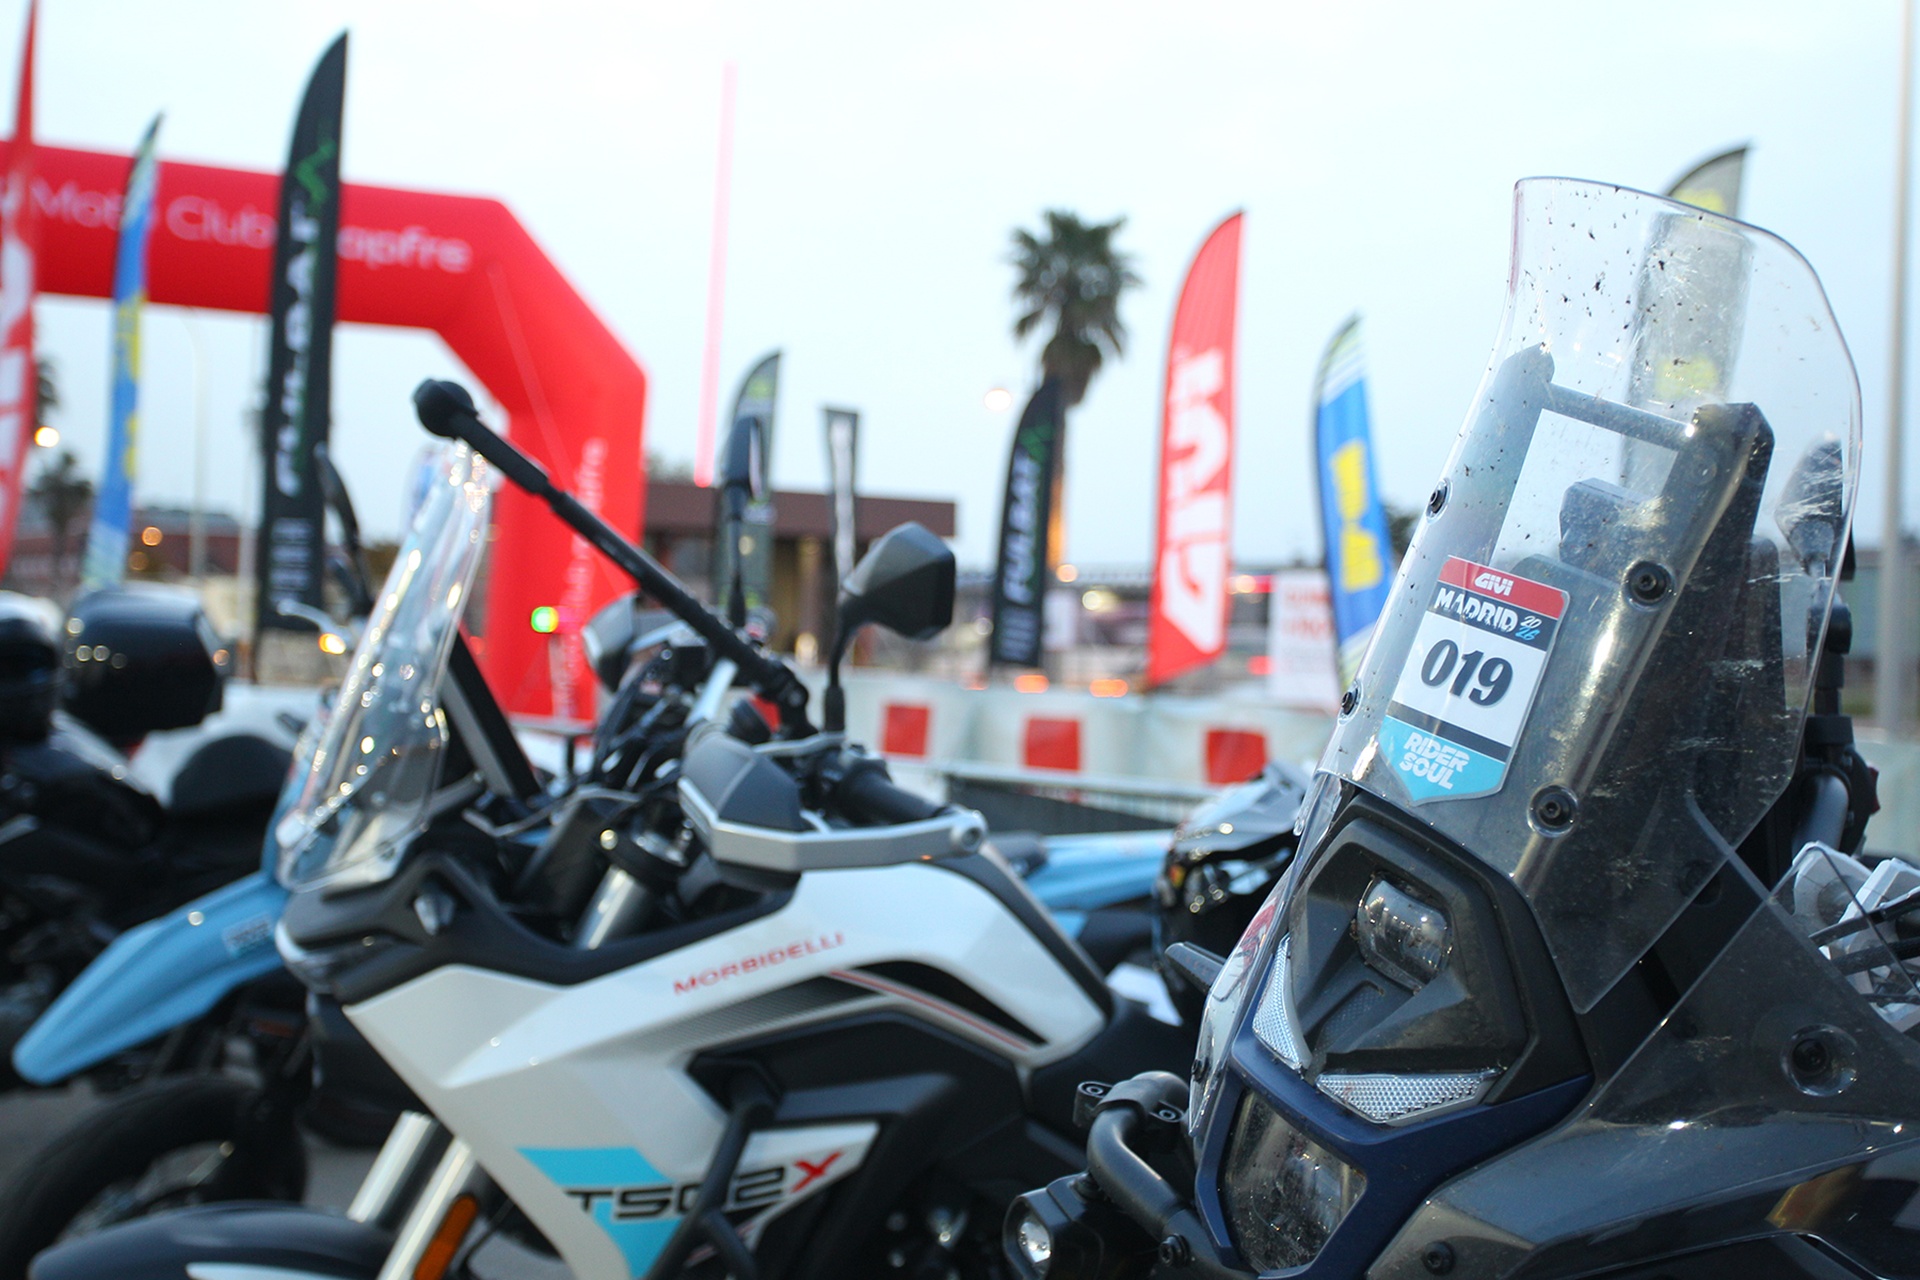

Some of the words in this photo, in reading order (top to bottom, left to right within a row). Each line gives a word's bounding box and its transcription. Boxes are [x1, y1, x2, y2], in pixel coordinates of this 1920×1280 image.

[165, 194, 277, 249] Club
[334, 225, 473, 274] apfre
[1474, 571, 1515, 597] GIVI
[1434, 587, 1519, 634] MADRID
[1421, 638, 1514, 708] 019
[1399, 752, 1454, 790] SOUL
[1403, 731, 1470, 773] RIDER
[673, 932, 845, 996] MORBIDELLI
